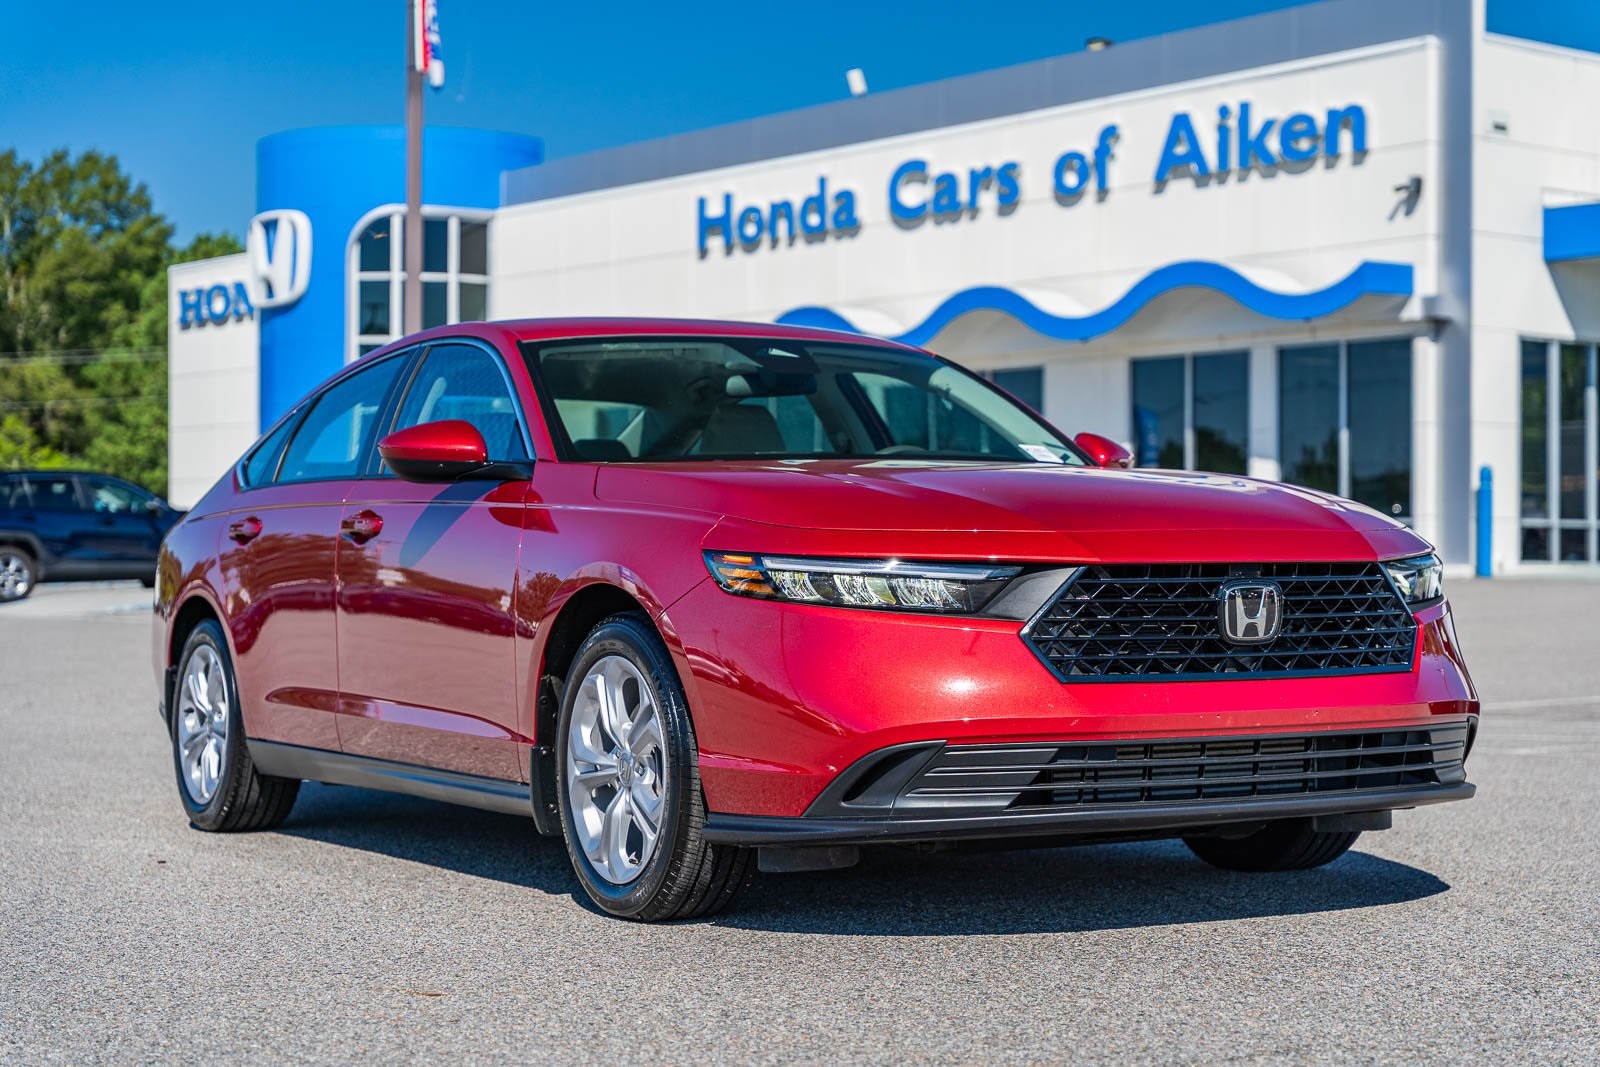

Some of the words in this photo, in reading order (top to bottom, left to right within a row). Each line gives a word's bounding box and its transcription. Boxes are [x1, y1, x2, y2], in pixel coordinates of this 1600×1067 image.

[697, 175, 859, 252] Honda
[889, 159, 1019, 220] Cars
[1054, 124, 1118, 195] of
[1154, 101, 1367, 183] Aiken
